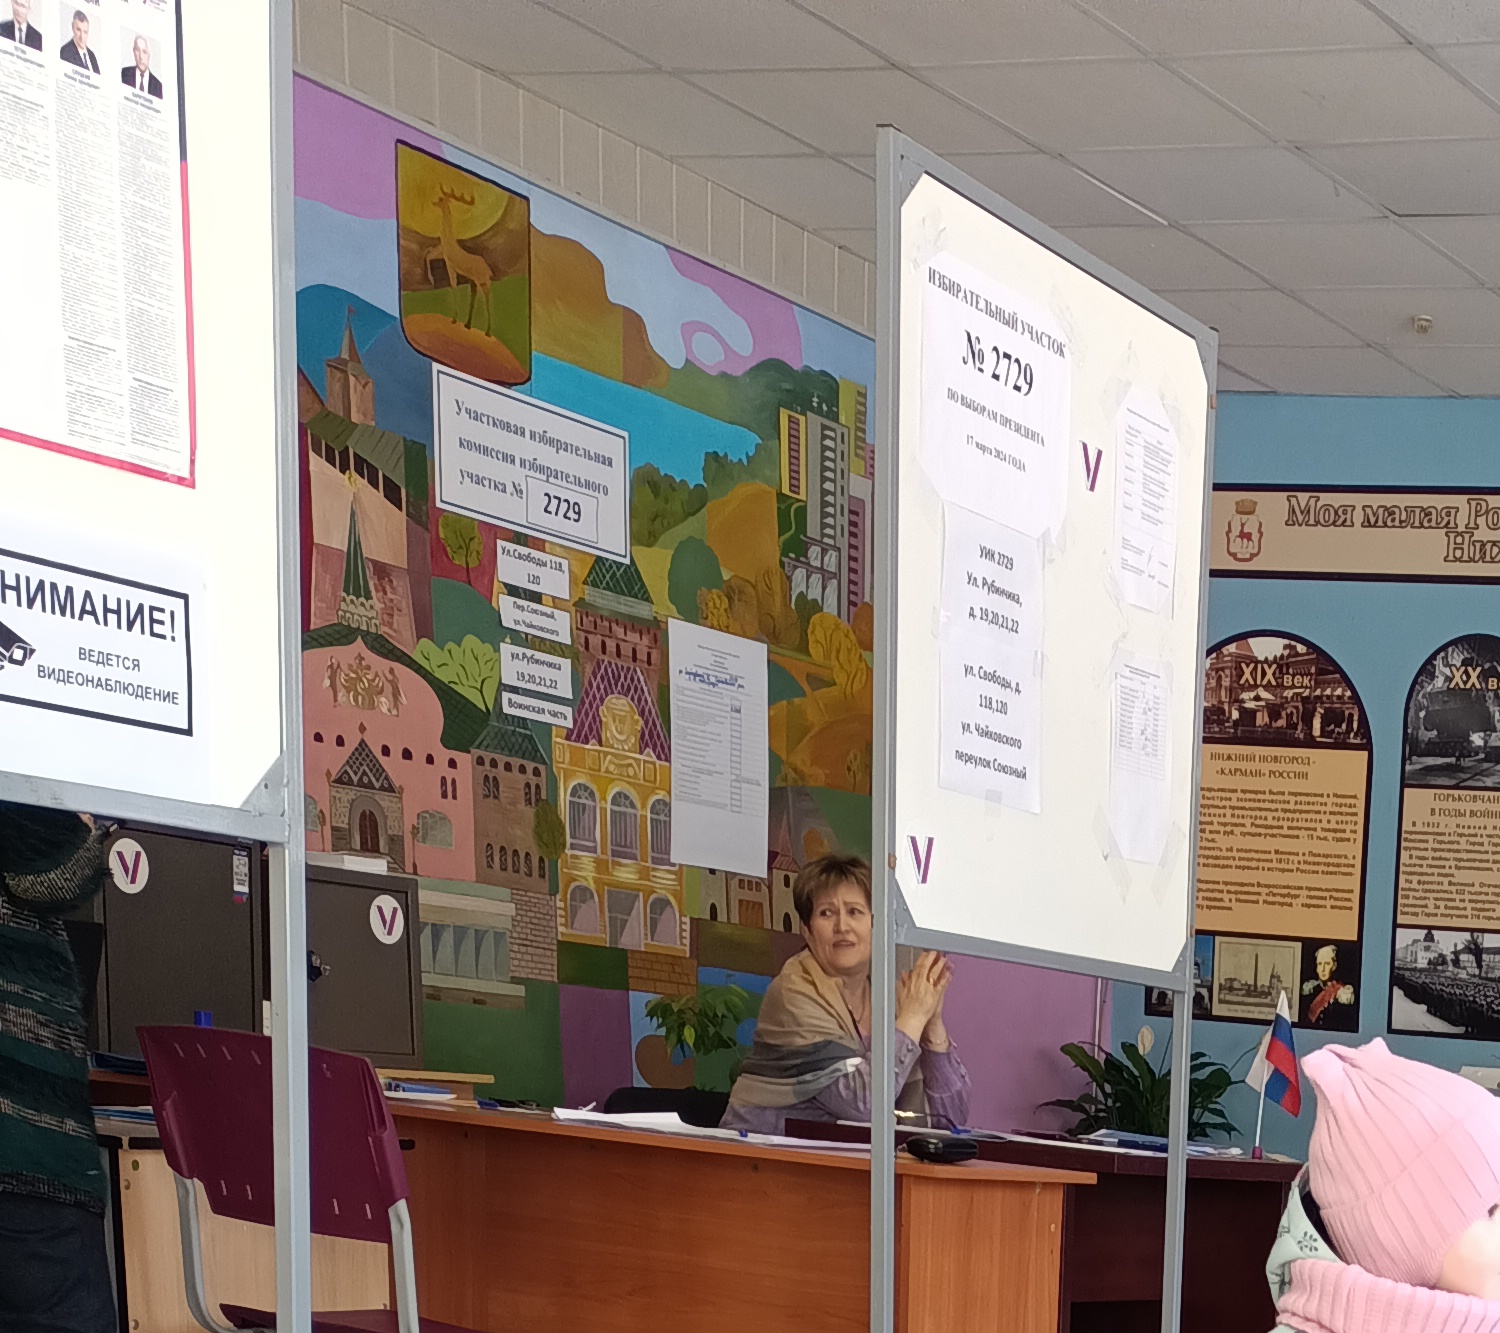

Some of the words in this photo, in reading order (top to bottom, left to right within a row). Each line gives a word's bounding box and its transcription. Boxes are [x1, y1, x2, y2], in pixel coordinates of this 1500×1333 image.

[928, 266, 1018, 333] ИЗБИРАТЕЛЬНЫЙ
[1020, 319, 1067, 359] УЧАСТОК
[962, 328, 985, 374] №
[991, 345, 1034, 397] 2729
[946, 387, 960, 401] ПО
[960, 393, 998, 424] ВЫБОРАМ
[999, 413, 1045, 448] ПРЕЗИДЕНТА
[454, 399, 526, 438] Участковая
[529, 430, 614, 468] избирательная
[458, 437, 516, 466] комиссия
[519, 457, 609, 496] избирательного
[966, 434, 974, 446] 17
[1008, 453, 1027, 473] ГОДА
[459, 468, 507, 495] участка
[510, 480, 524, 499] №
[543, 492, 582, 523] 2729
[1285, 495, 1355, 529] Моя
[1360, 501, 1460, 532] малая
[979, 543, 995, 562] УИК
[997, 551, 1014, 571] 2729
[527, 572, 541, 586] 120
[967, 571, 979, 588] Ул.
[979, 606, 1019, 634] 19,20,21,22
[78, 646, 141, 673] ВЕДЕТСЯ
[963, 662, 976, 679] ул.
[37, 664, 180, 706] ВИДЕОНАБЛЮДЕНИЕ
[516, 670, 558, 690] 19,20,21,22
[1239, 662, 1279, 687] XIX
[1283, 673, 1312, 688] век
[1448, 665, 1483, 690] XX
[507, 696, 546, 716] Воинская
[979, 693, 1008, 716] 118,120
[961, 720, 973, 737] ул.
[955, 748, 992, 771] переулок
[993, 757, 1027, 782] Союзный
[1209, 751, 1257, 764] НИЖНИЙ
[1258, 753, 1311, 767] НОВГОРОД
[1268, 769, 1309, 781] РОССИИ
[1430, 807, 1436, 817] В
[1438, 807, 1467, 819] ГОДЫ
